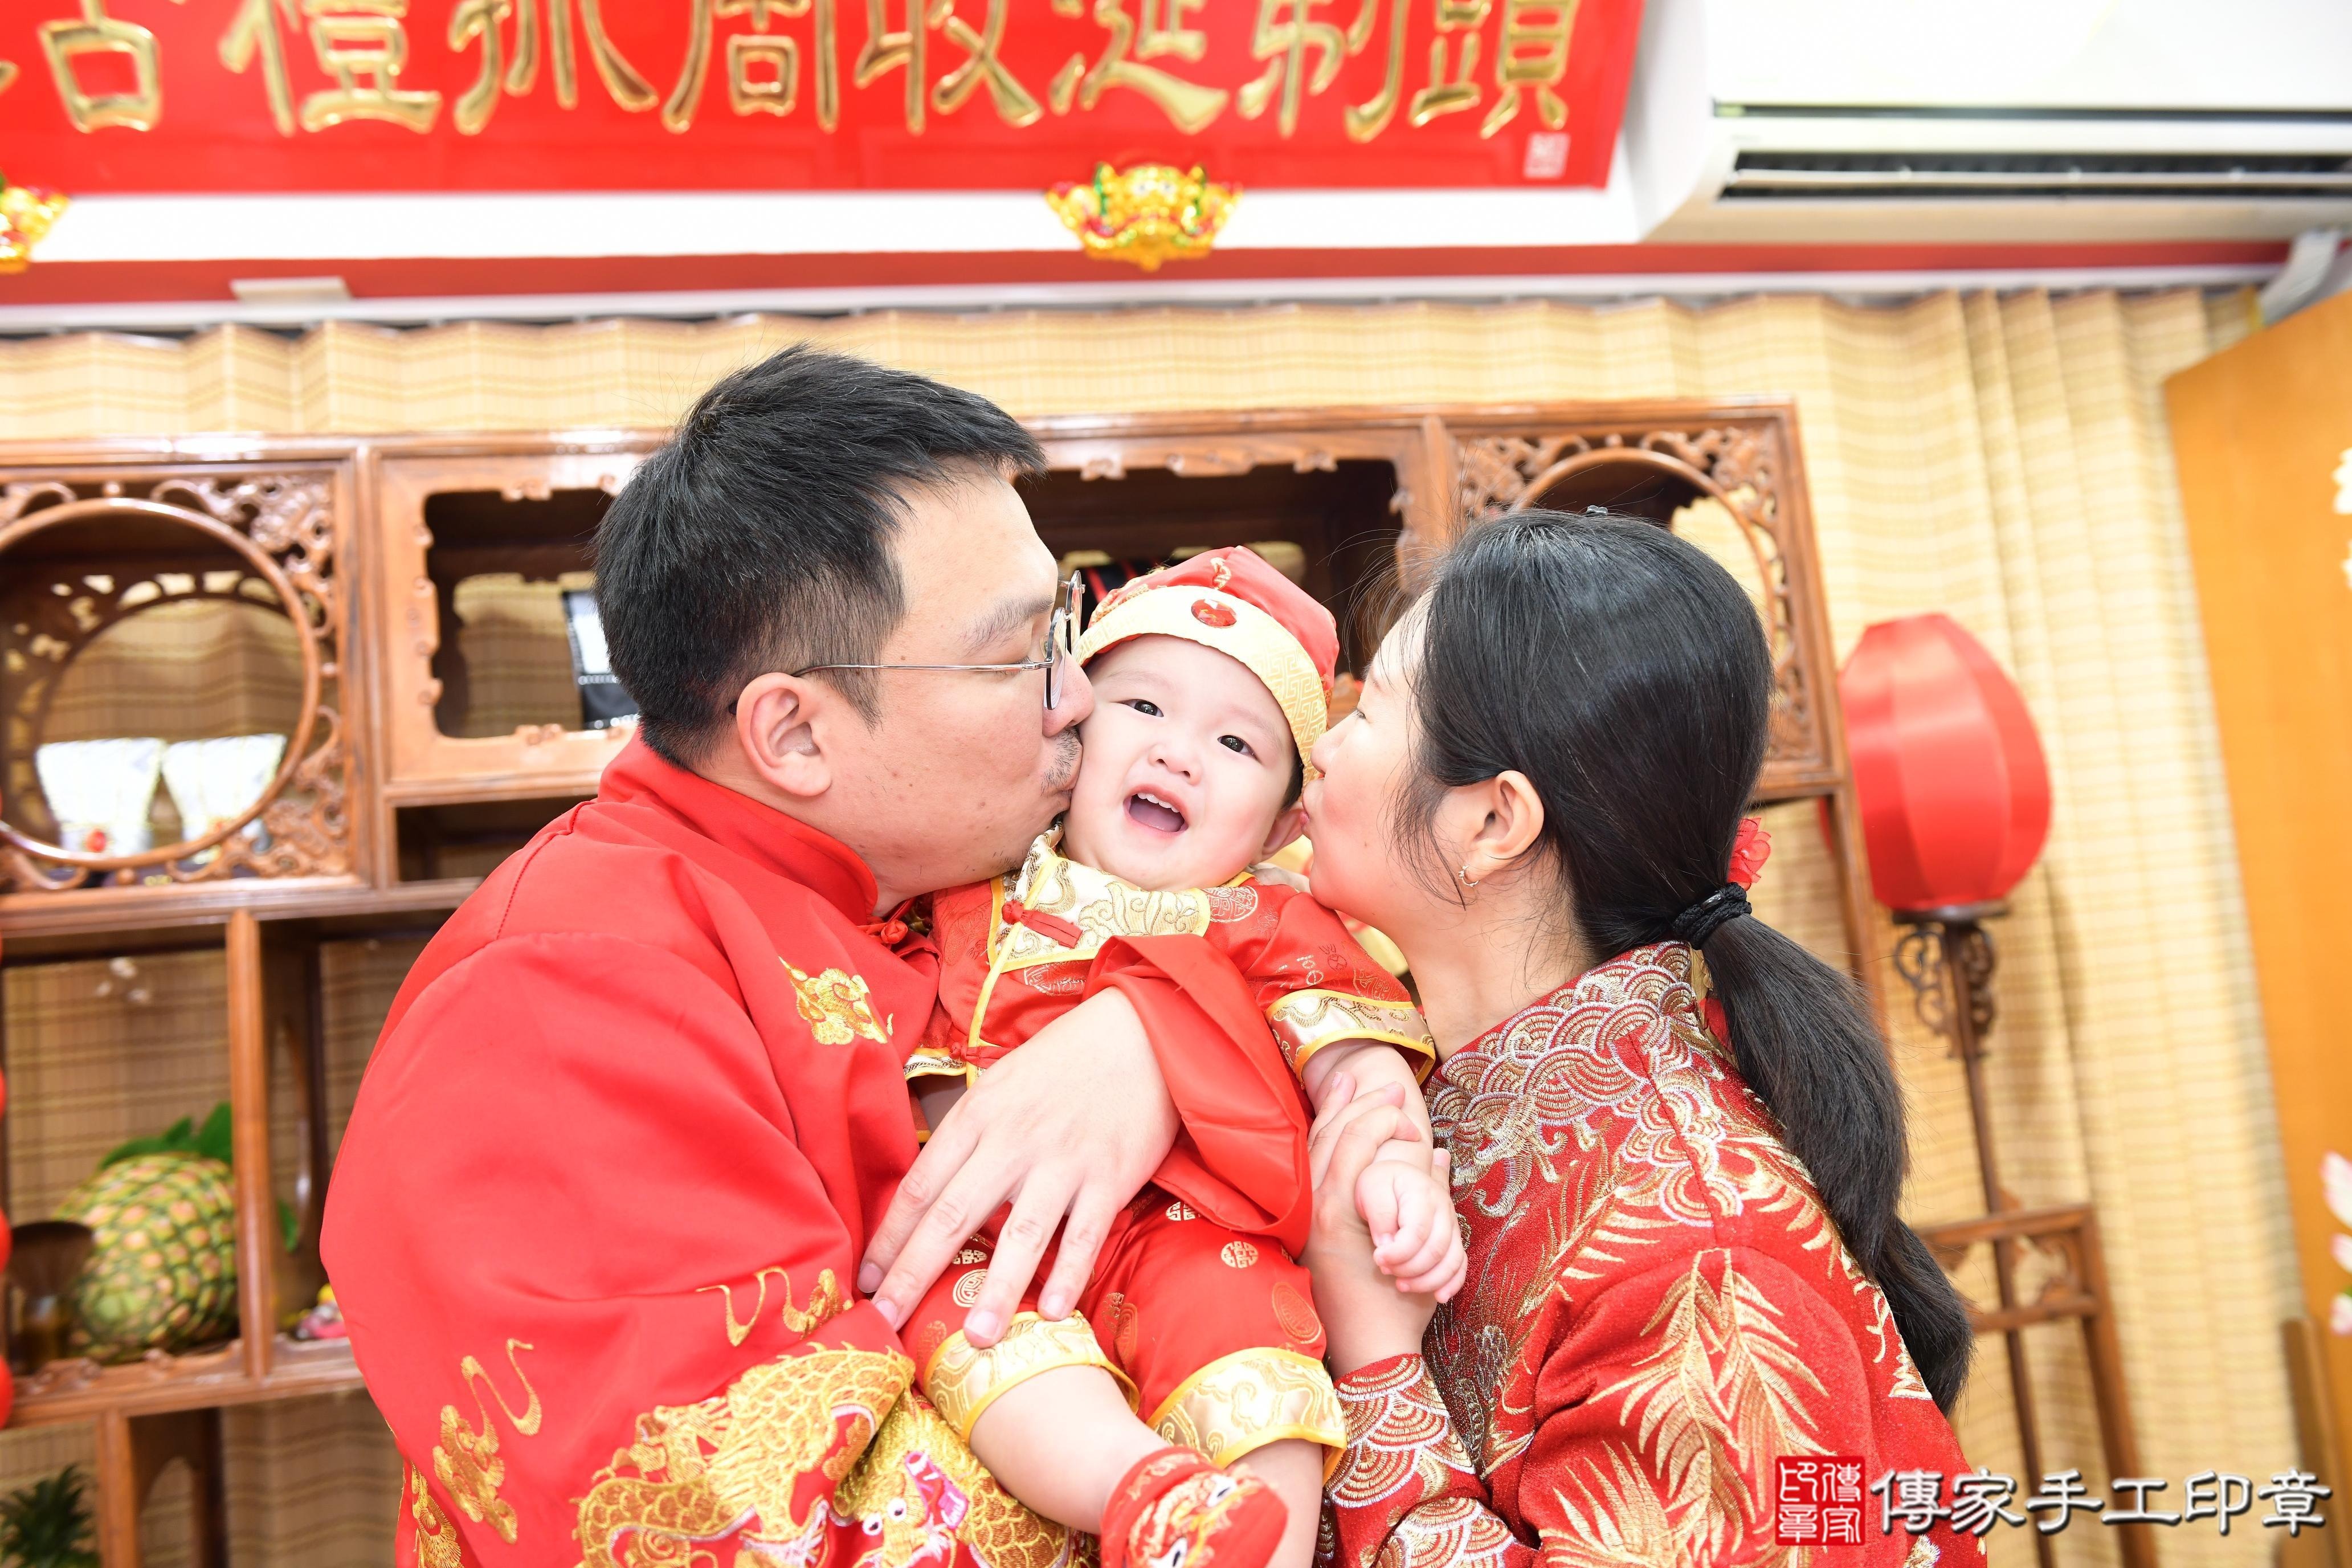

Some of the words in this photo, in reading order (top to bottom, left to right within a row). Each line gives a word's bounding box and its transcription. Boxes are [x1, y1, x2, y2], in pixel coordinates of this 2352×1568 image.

[0, 0, 1580, 144] 古禮抓周收涎剃頭
